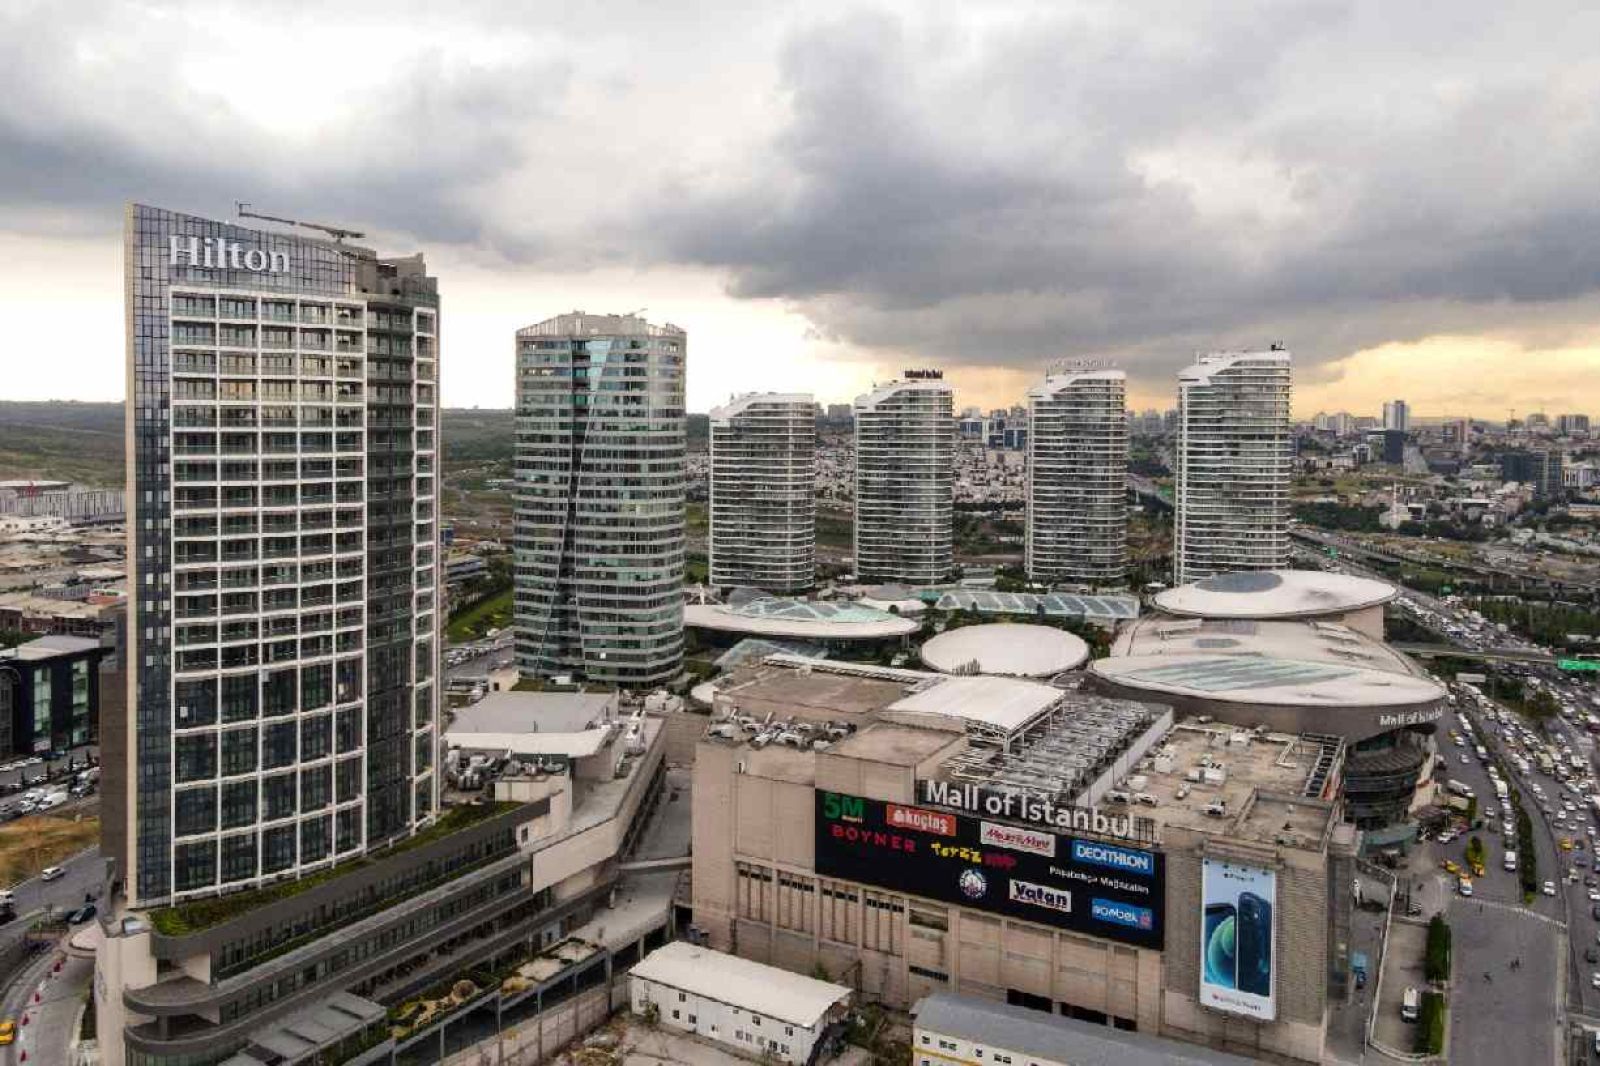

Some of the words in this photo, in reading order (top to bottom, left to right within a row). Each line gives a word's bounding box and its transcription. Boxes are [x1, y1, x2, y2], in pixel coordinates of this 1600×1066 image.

[169, 235, 290, 273] Hilton
[824, 792, 863, 819] 5M
[926, 780, 979, 811] Mall
[985, 791, 1016, 816] of
[831, 824, 916, 853] BOYNER
[1076, 844, 1149, 870] DECATHLON
[1013, 881, 1067, 906] Vatan
